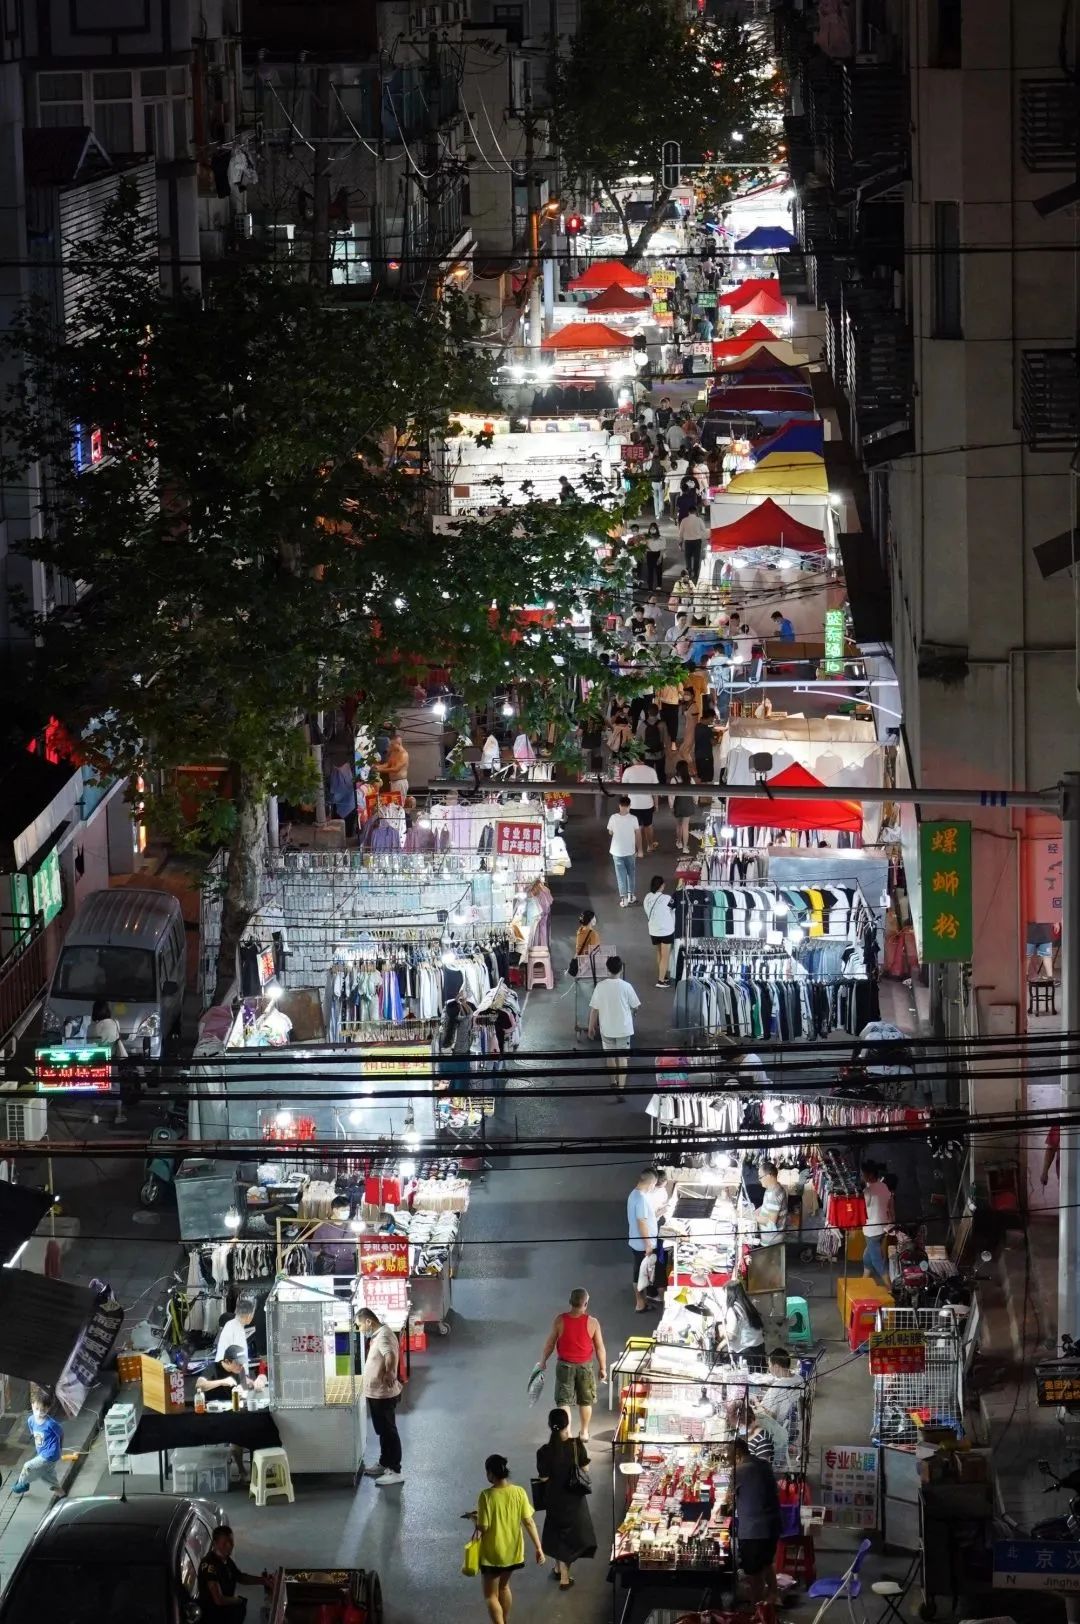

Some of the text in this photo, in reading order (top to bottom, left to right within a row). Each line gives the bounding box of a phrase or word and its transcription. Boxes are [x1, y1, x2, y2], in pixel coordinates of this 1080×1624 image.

[931, 828, 959, 938] 螺蛳粉
[825, 1450, 875, 1472] 专业贴膜
[1006, 1576, 1016, 1585] N
